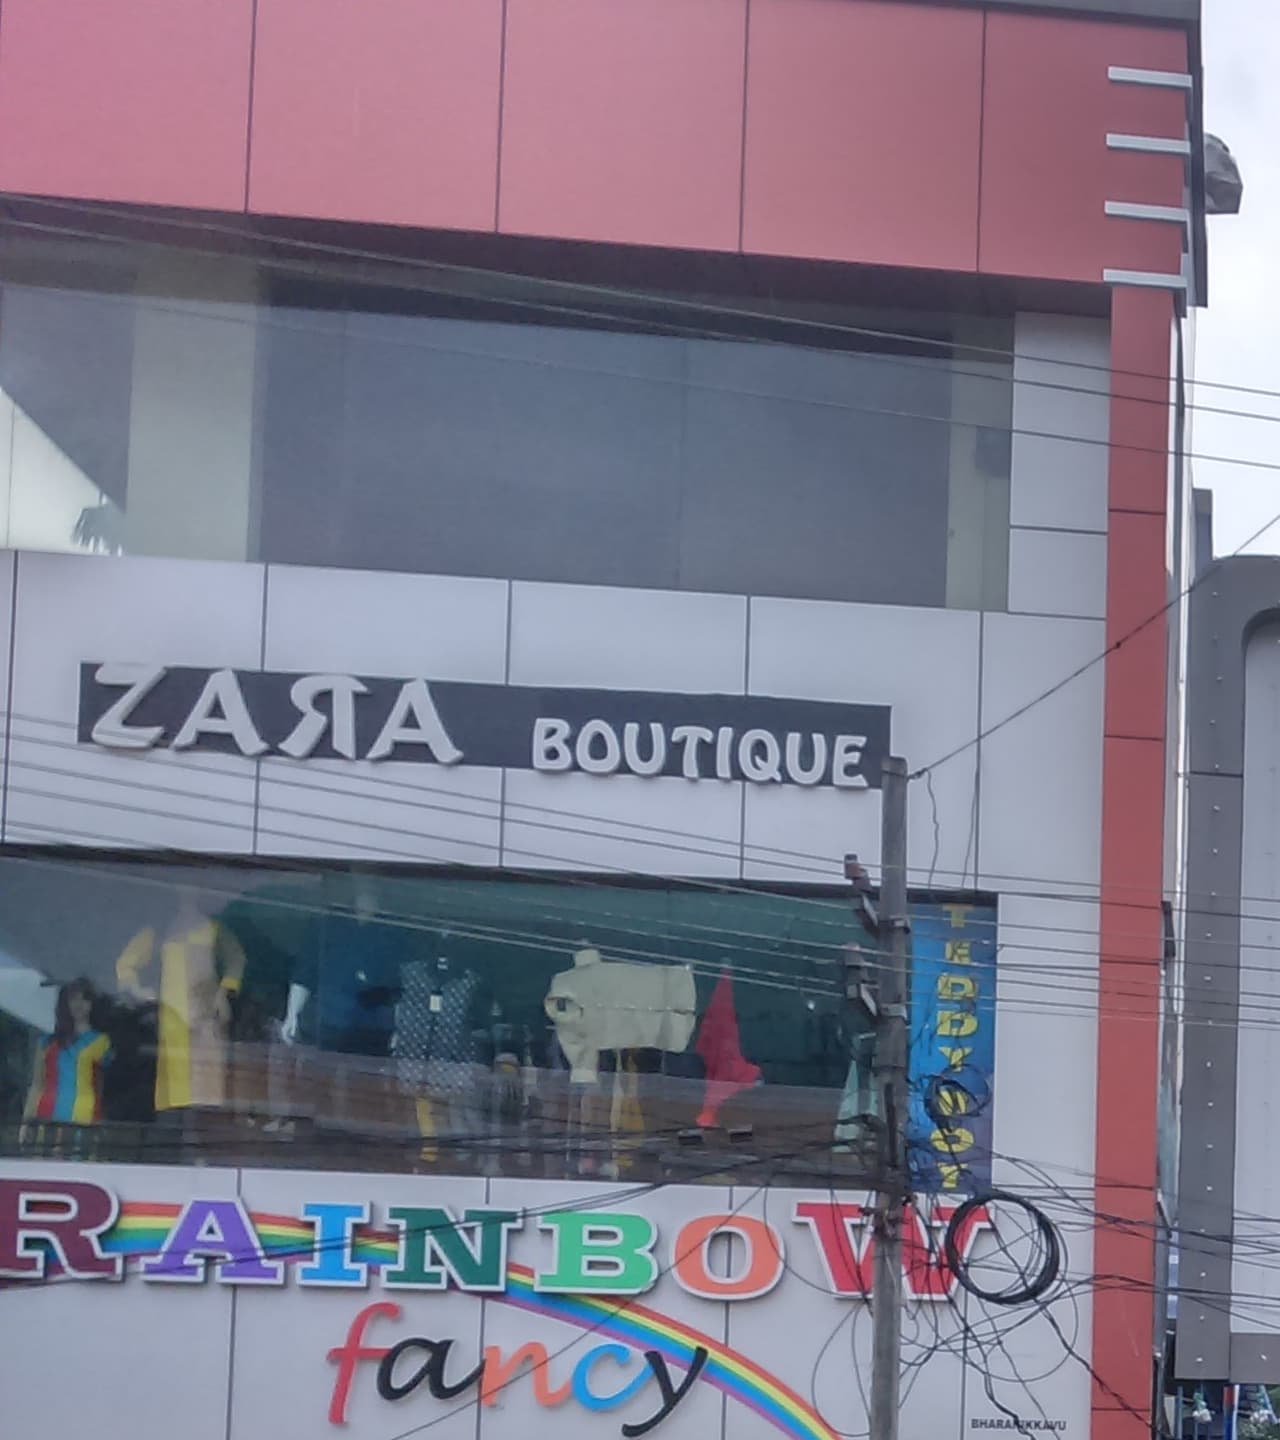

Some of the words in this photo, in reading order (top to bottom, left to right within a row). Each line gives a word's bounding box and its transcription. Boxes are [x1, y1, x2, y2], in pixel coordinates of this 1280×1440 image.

[532, 717, 868, 789] BOUTIQUE
[0, 1177, 997, 1303] RAINBOW
[327, 1302, 708, 1439] fancy
